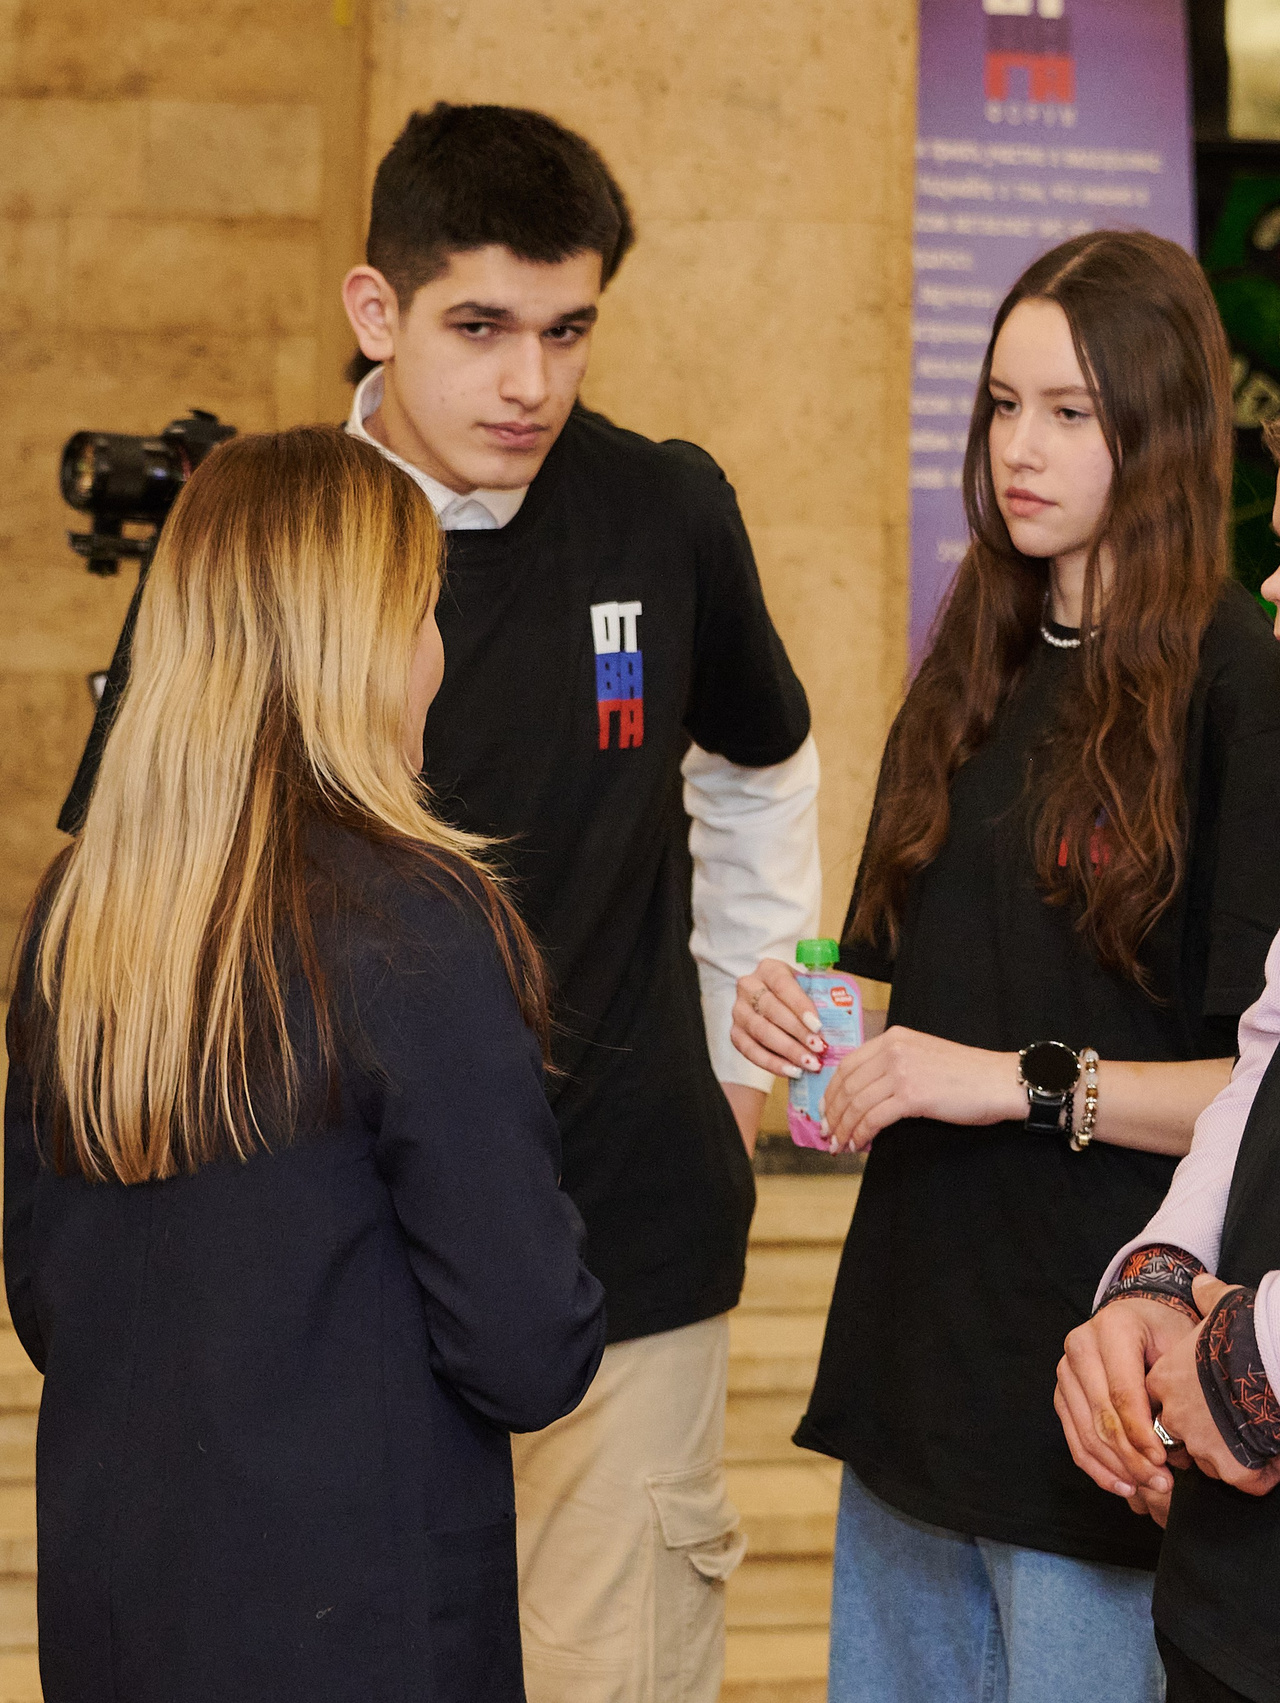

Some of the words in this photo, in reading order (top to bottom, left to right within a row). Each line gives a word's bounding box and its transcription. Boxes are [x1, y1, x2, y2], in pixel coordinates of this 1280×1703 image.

[590, 601, 642, 654] ОТ
[595, 650, 643, 701] ВА
[598, 698, 644, 750] ГА
